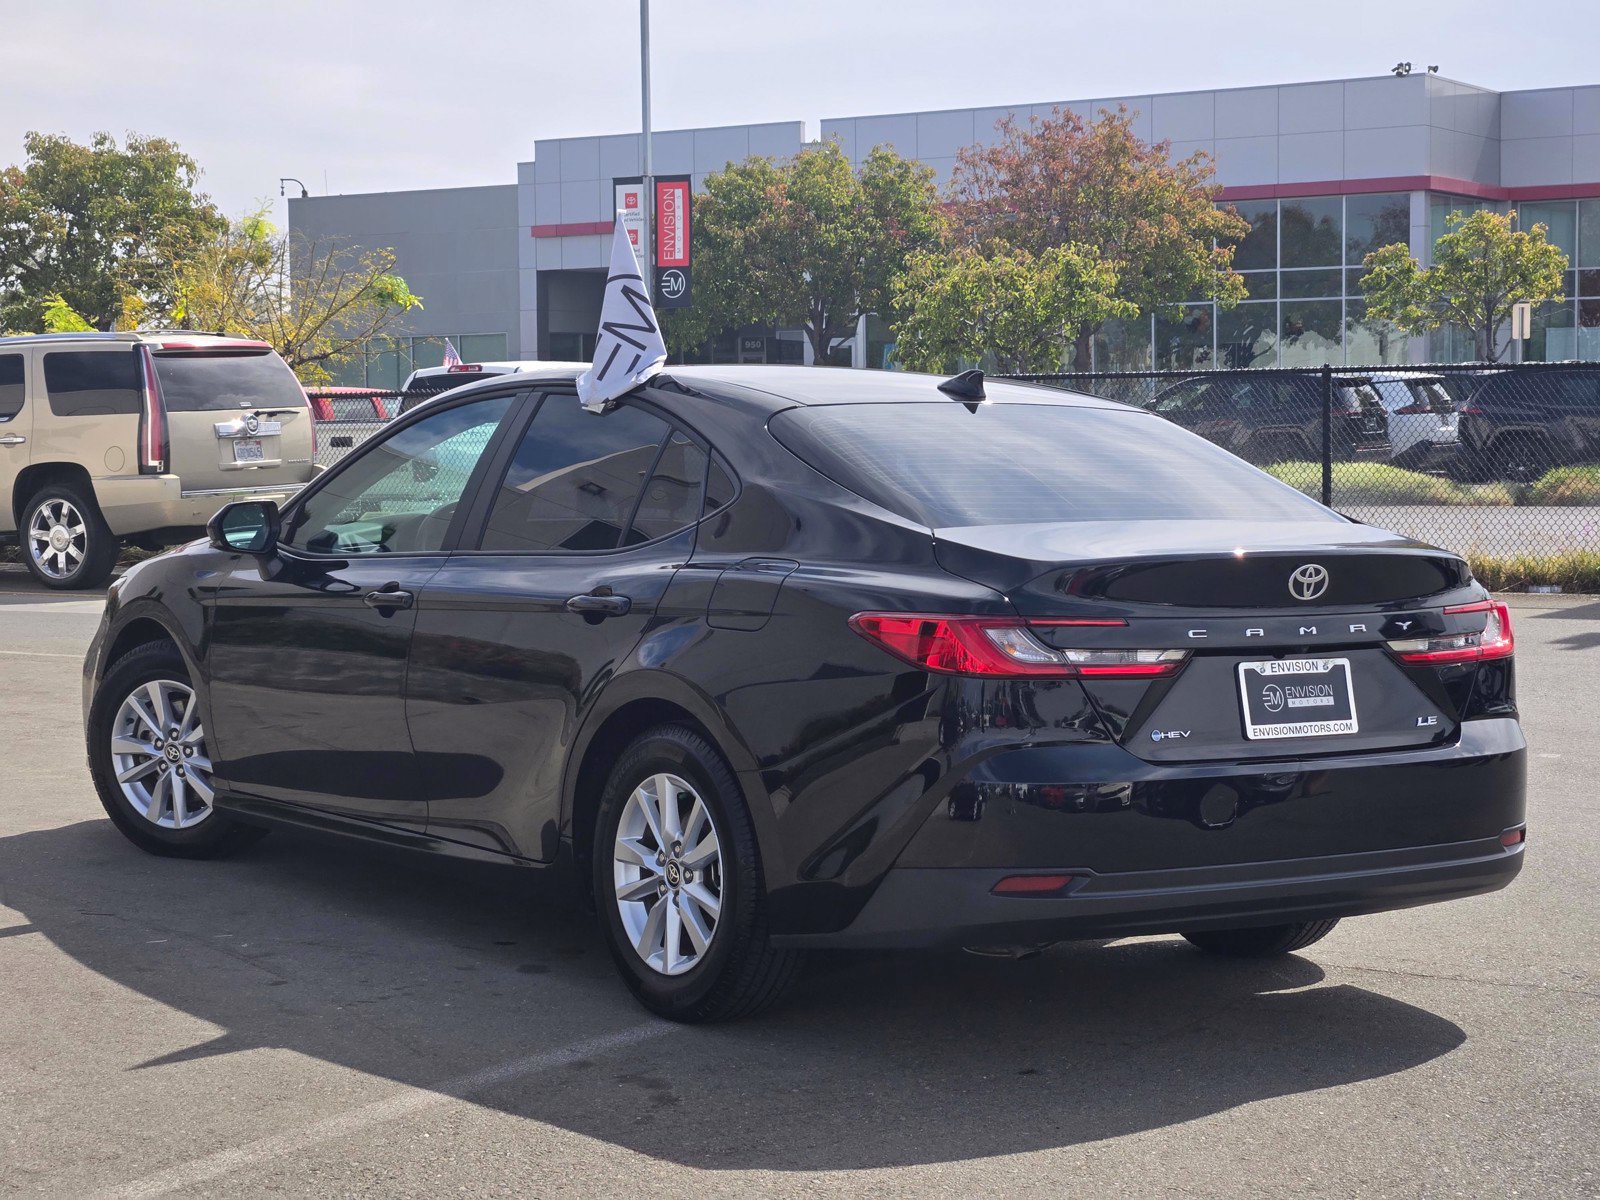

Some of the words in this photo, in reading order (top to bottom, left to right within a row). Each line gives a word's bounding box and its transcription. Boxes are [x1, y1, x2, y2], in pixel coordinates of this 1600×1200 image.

[663, 188, 675, 260] ENVISION
[744, 340, 762, 349] 950
[1188, 621, 1412, 638] CAMRY
[1270, 661, 1318, 673] ENVISION
[1285, 684, 1334, 698] ENVISION
[1291, 698, 1331, 706] MOTORS
[1417, 715, 1438, 727] LE
[1253, 722, 1354, 737] ENVISIONMOTORS.COM
